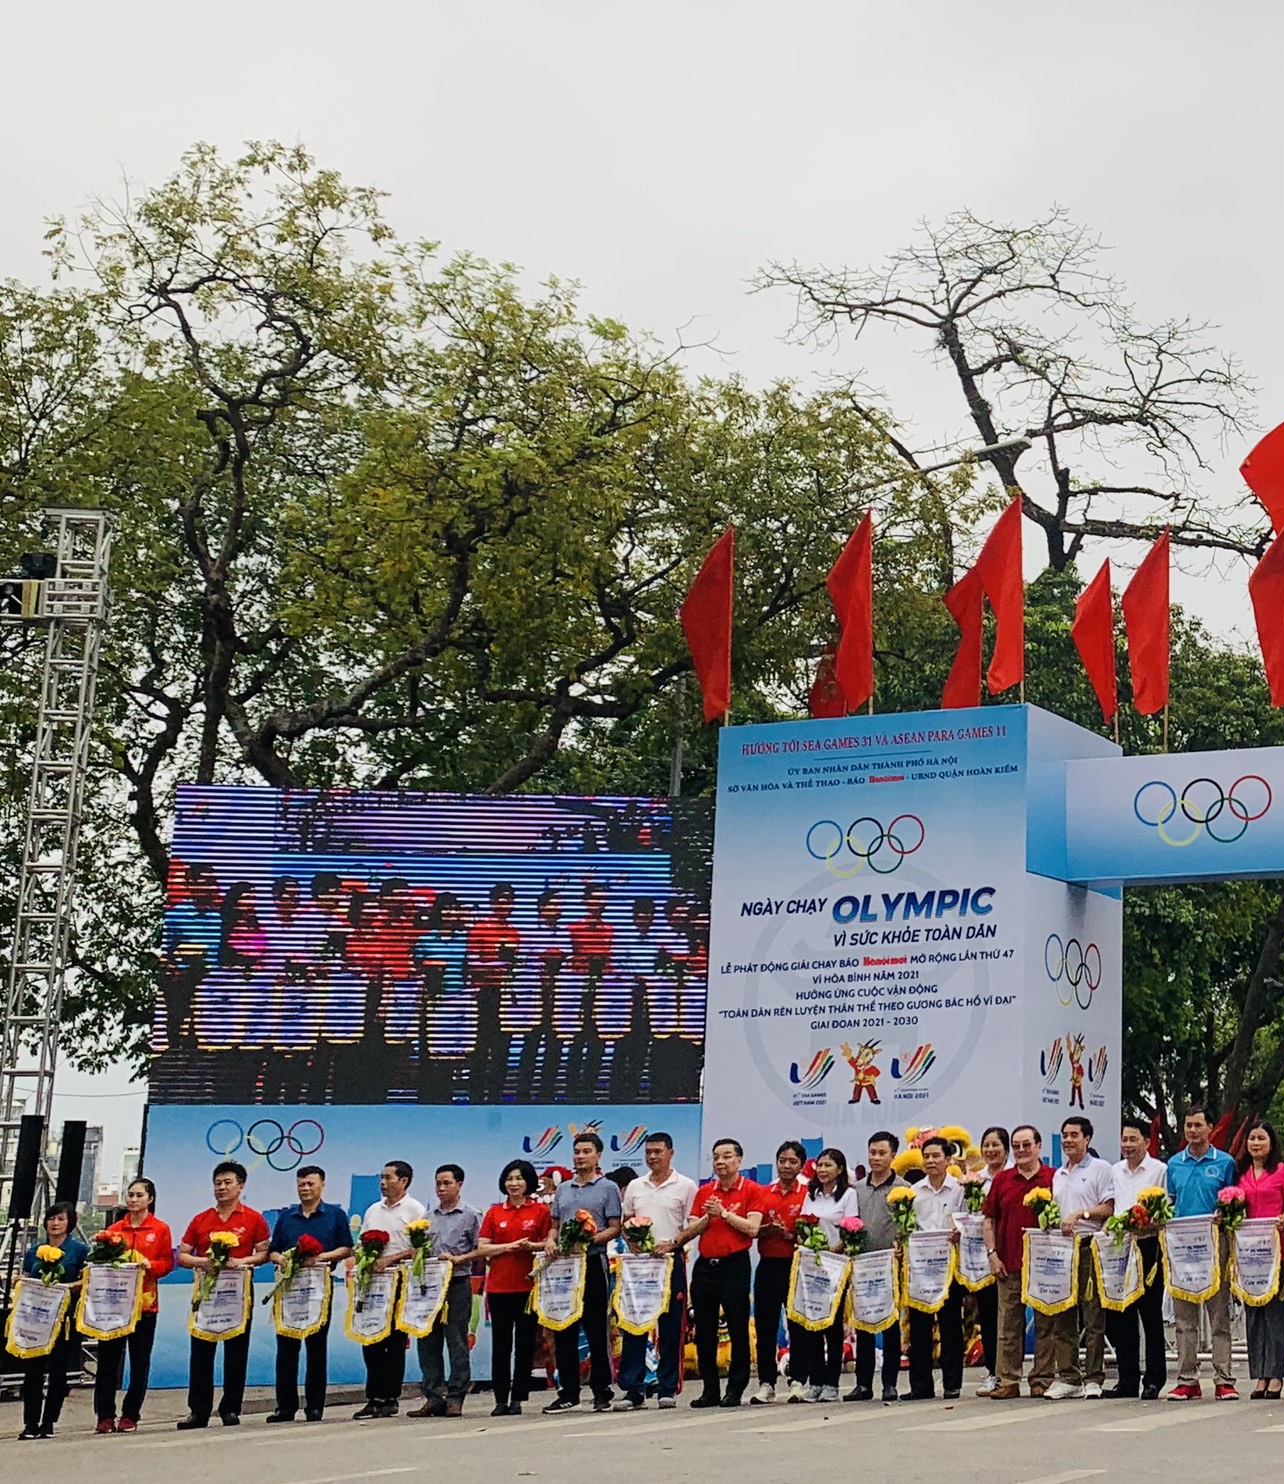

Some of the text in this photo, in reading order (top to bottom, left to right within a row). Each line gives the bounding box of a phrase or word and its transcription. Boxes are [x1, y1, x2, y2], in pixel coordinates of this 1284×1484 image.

[741, 887, 996, 924] NGÀY CHẠY OLYMPIC
[834, 923, 997, 947] VÌ SỨC KHỎE TOÀN DÂN
[811, 1016, 918, 1029] GIAI ĐOẠN 2021 2030
